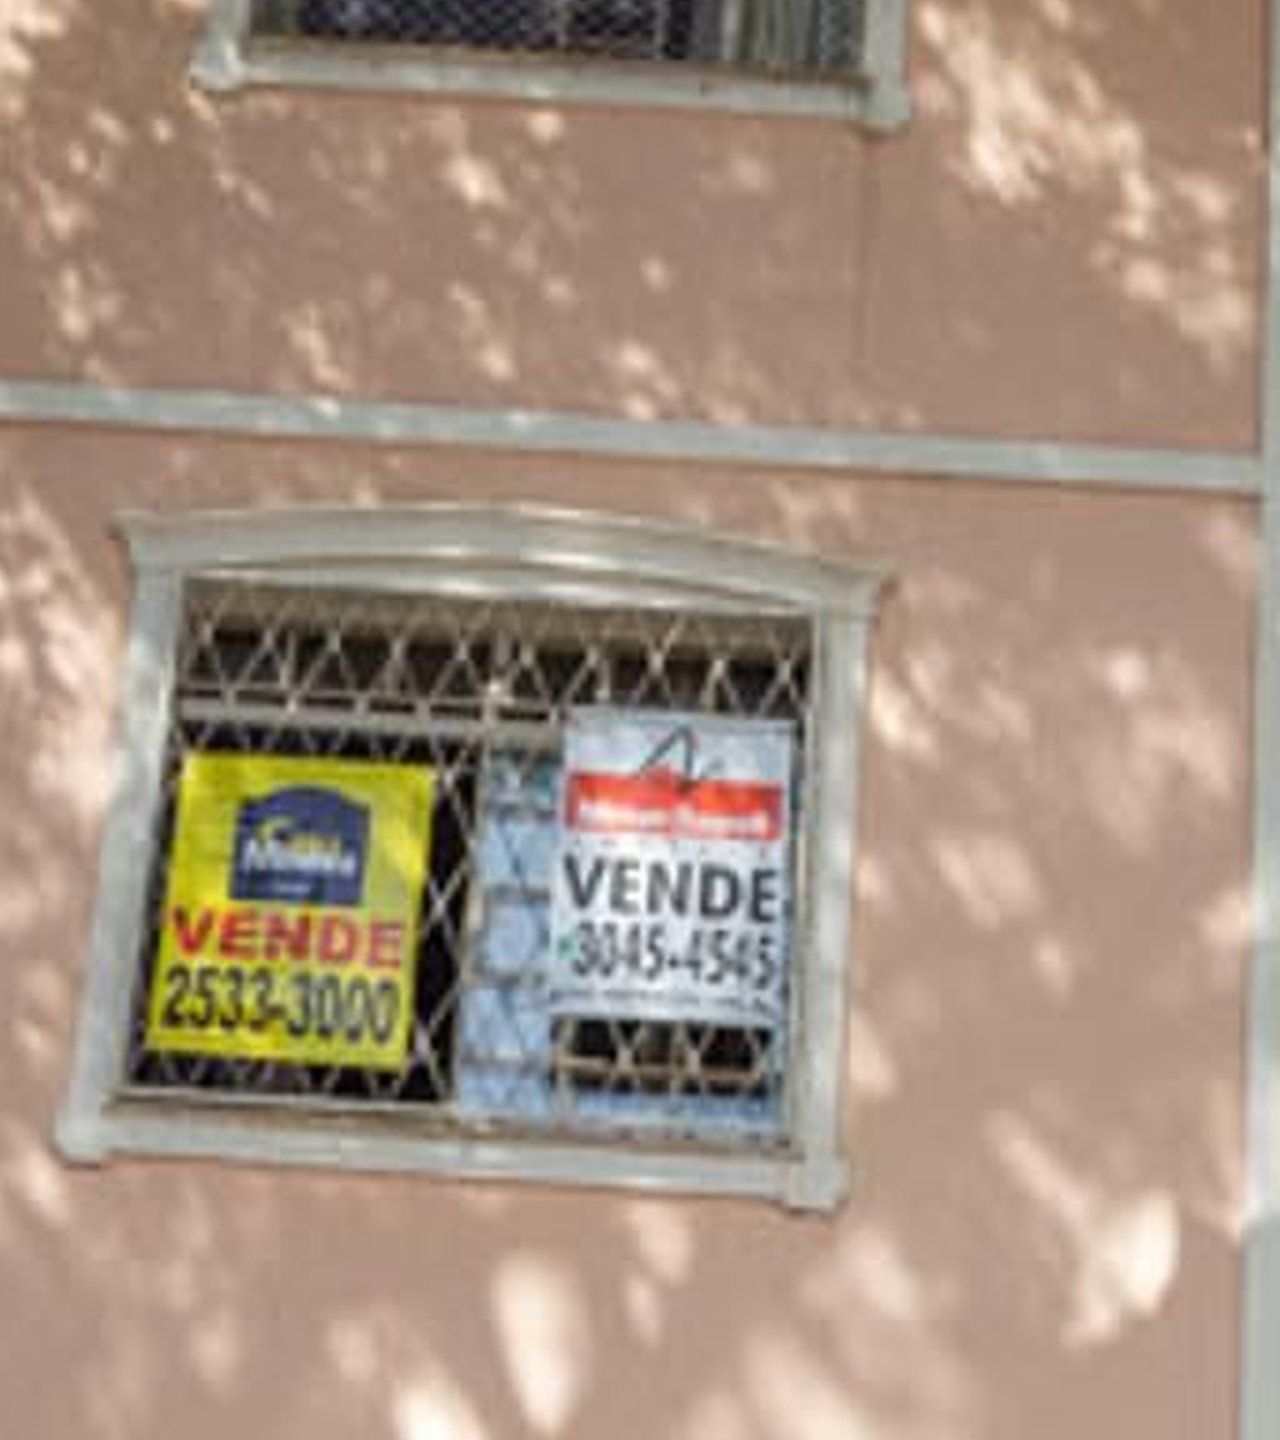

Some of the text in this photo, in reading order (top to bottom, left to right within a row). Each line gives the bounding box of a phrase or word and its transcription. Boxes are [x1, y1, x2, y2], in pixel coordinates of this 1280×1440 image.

[563, 853, 779, 924] VENDE
[169, 904, 404, 969] VENDE
[161, 963, 400, 1044] 2533-3000
